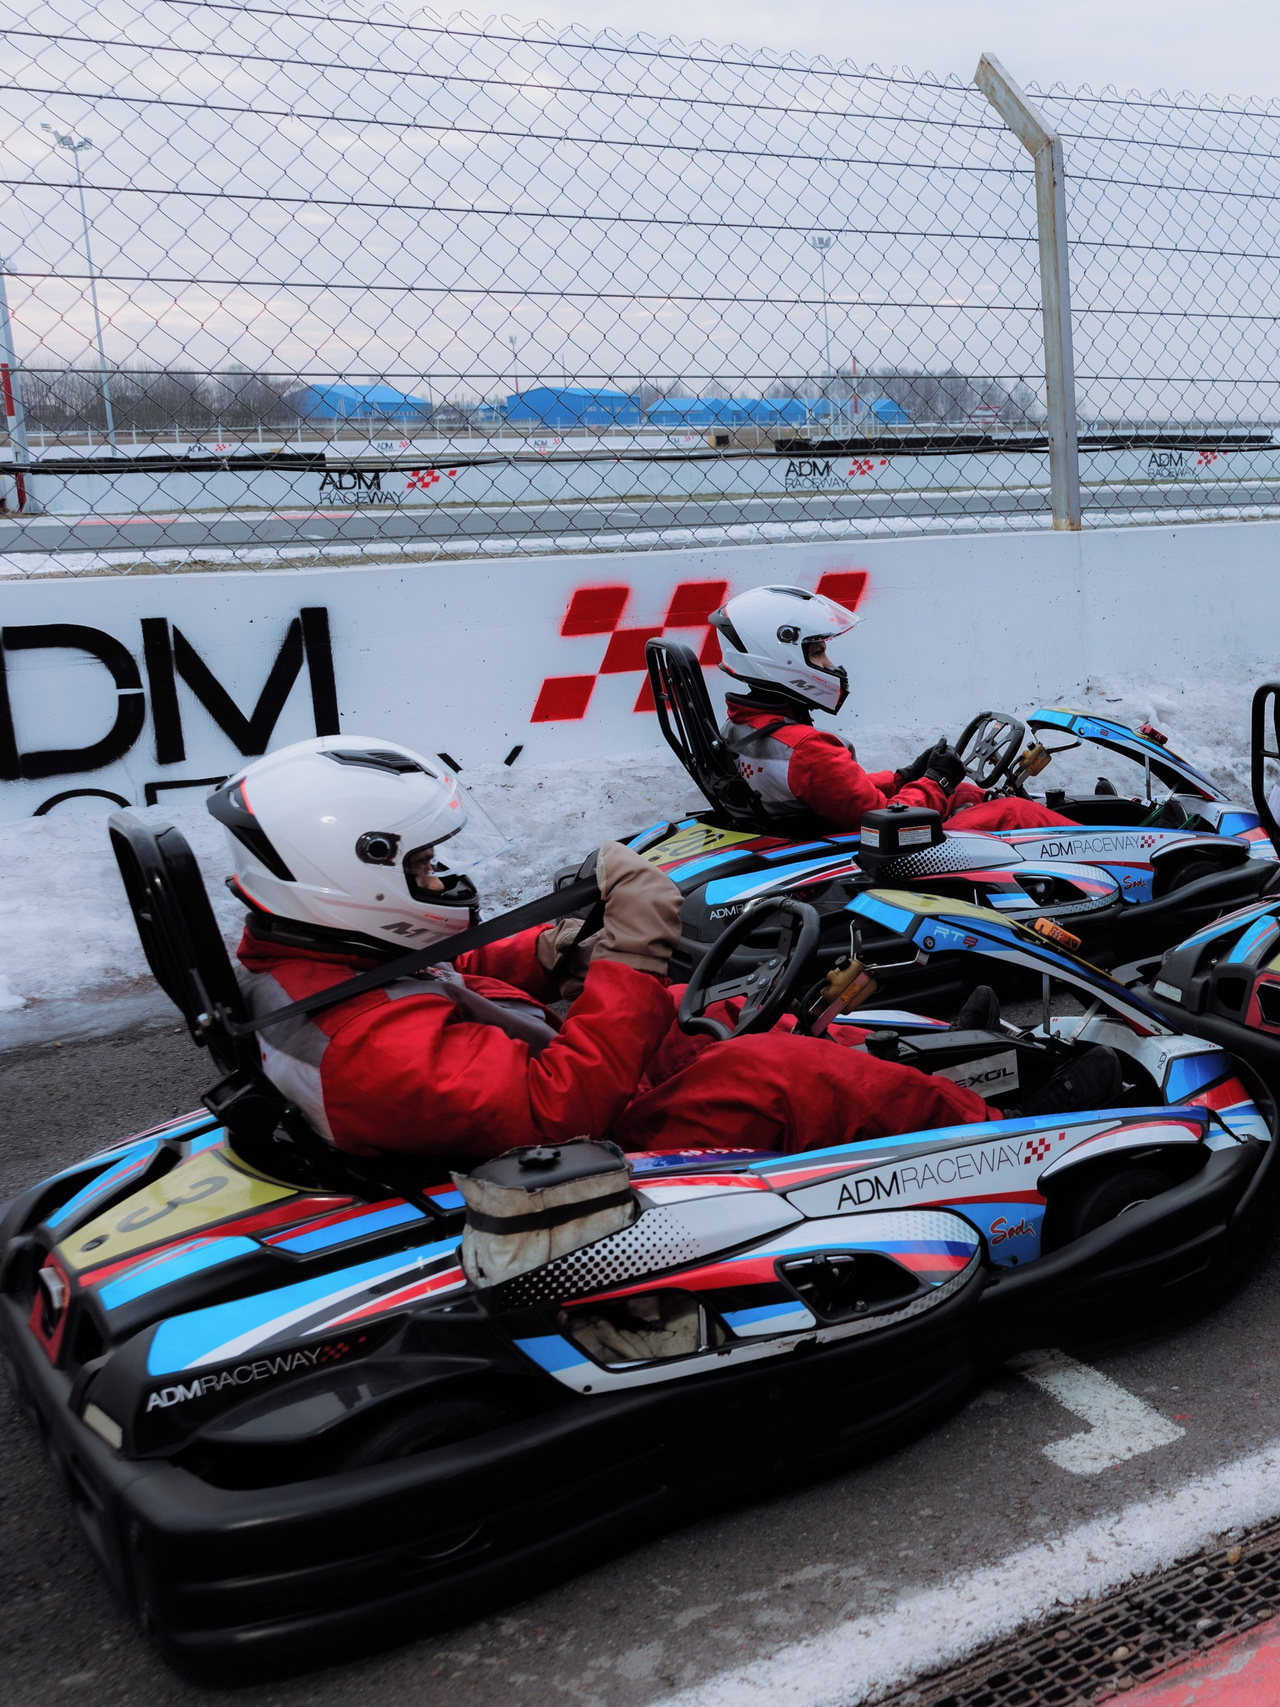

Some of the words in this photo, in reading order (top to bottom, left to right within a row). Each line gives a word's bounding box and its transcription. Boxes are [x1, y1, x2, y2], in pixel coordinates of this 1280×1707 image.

[785, 460, 830, 477] ADM
[1148, 452, 1183, 467] ADM
[319, 471, 381, 491] ADM
[320, 490, 404, 504] RACEWAY
[0, 606, 340, 780] DM
[1083, 722, 1109, 737] RT8
[656, 828, 726, 857] 20
[1040, 835, 1140, 860] ADMRACEWAY
[1122, 875, 1149, 891] Sodi
[933, 925, 978, 949] RT8
[837, 1141, 1024, 1211] ADMRACEWAY
[116, 1174, 229, 1235] 3
[989, 1216, 1035, 1246] Sodi
[146, 1346, 323, 1413] ADMRACEWAY
